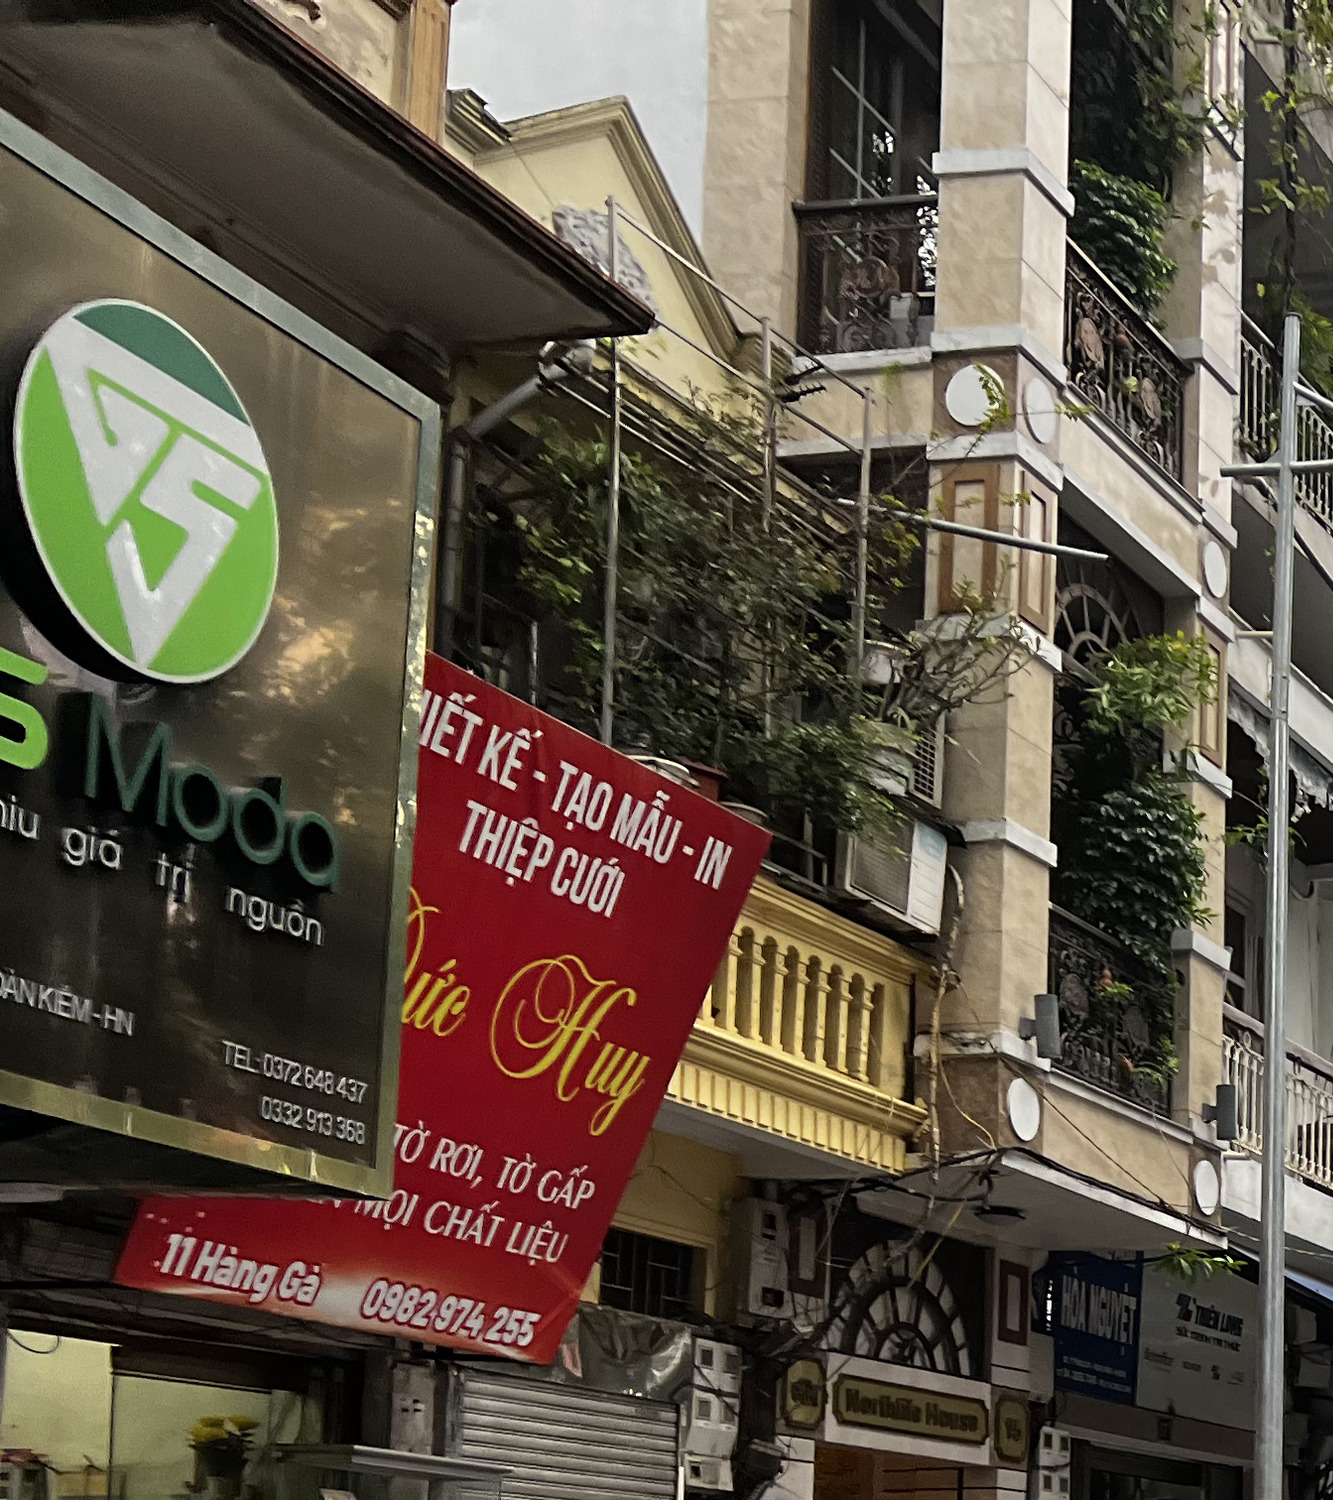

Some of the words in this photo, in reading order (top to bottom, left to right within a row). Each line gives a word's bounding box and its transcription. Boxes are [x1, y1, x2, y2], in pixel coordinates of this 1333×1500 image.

[418, 688, 484, 765] IẾT
[477, 725, 543, 791] KẾ
[551, 760, 614, 832] TẠO
[609, 789, 683, 865] MẪU
[693, 836, 733, 890] IN
[458, 799, 555, 887] THIỆP
[262, 1053, 303, 1086] 0372
[303, 1065, 335, 1097] 648
[335, 1076, 369, 1105] 437
[491, 954, 651, 1136] Huy
[260, 1095, 303, 1130] 0332
[304, 1108, 334, 1137] 913
[429, 1137, 484, 1190] RƠI,
[497, 1153, 538, 1194] TỜ
[537, 1165, 596, 1210] GẤP
[158, 1233, 197, 1277] 11
[192, 1239, 280, 1304] Hàng
[278, 1261, 321, 1306] Gà
[424, 1200, 506, 1247] CHẤT
[505, 1220, 569, 1266] LIỆU
